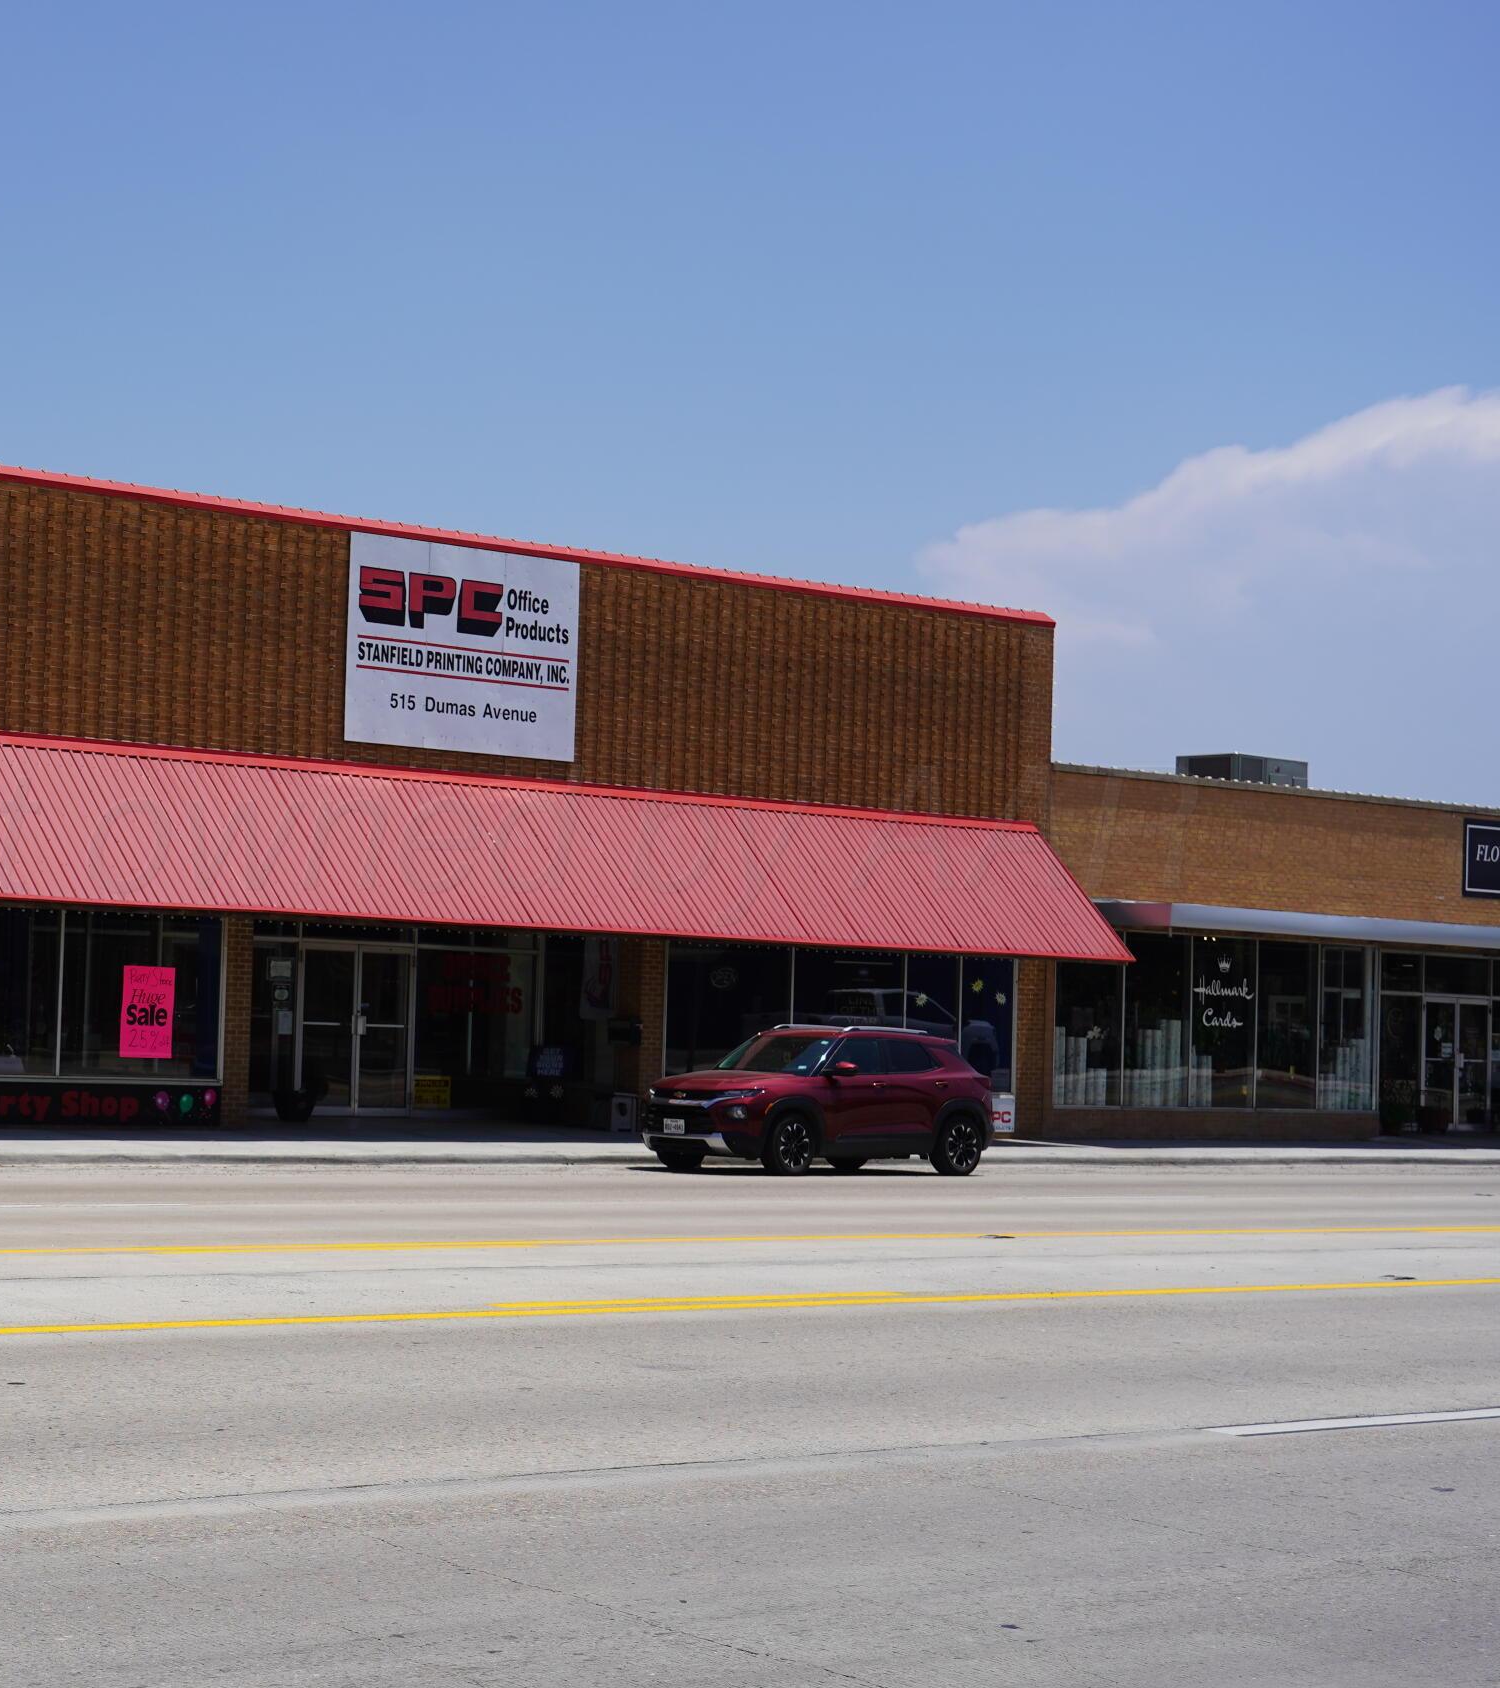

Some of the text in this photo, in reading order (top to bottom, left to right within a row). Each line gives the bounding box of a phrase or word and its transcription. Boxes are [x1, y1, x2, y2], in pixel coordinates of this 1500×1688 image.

[358, 565, 504, 638] SPC
[506, 588, 550, 615] Office
[505, 617, 570, 645] Products
[357, 641, 570, 685] STANFIELD PRINTING COMPANY, INC.
[389, 692, 538, 723] 515 Dumas Avenue
[1476, 844, 1500, 863] FLO
[130, 988, 167, 1005] Huge
[1193, 974, 1255, 1006] Hallmark
[126, 1003, 168, 1027] Sale
[1202, 1007, 1244, 1029] Cards
[60, 1090, 140, 1121] Shop
[990, 1110, 1012, 1124] PC
